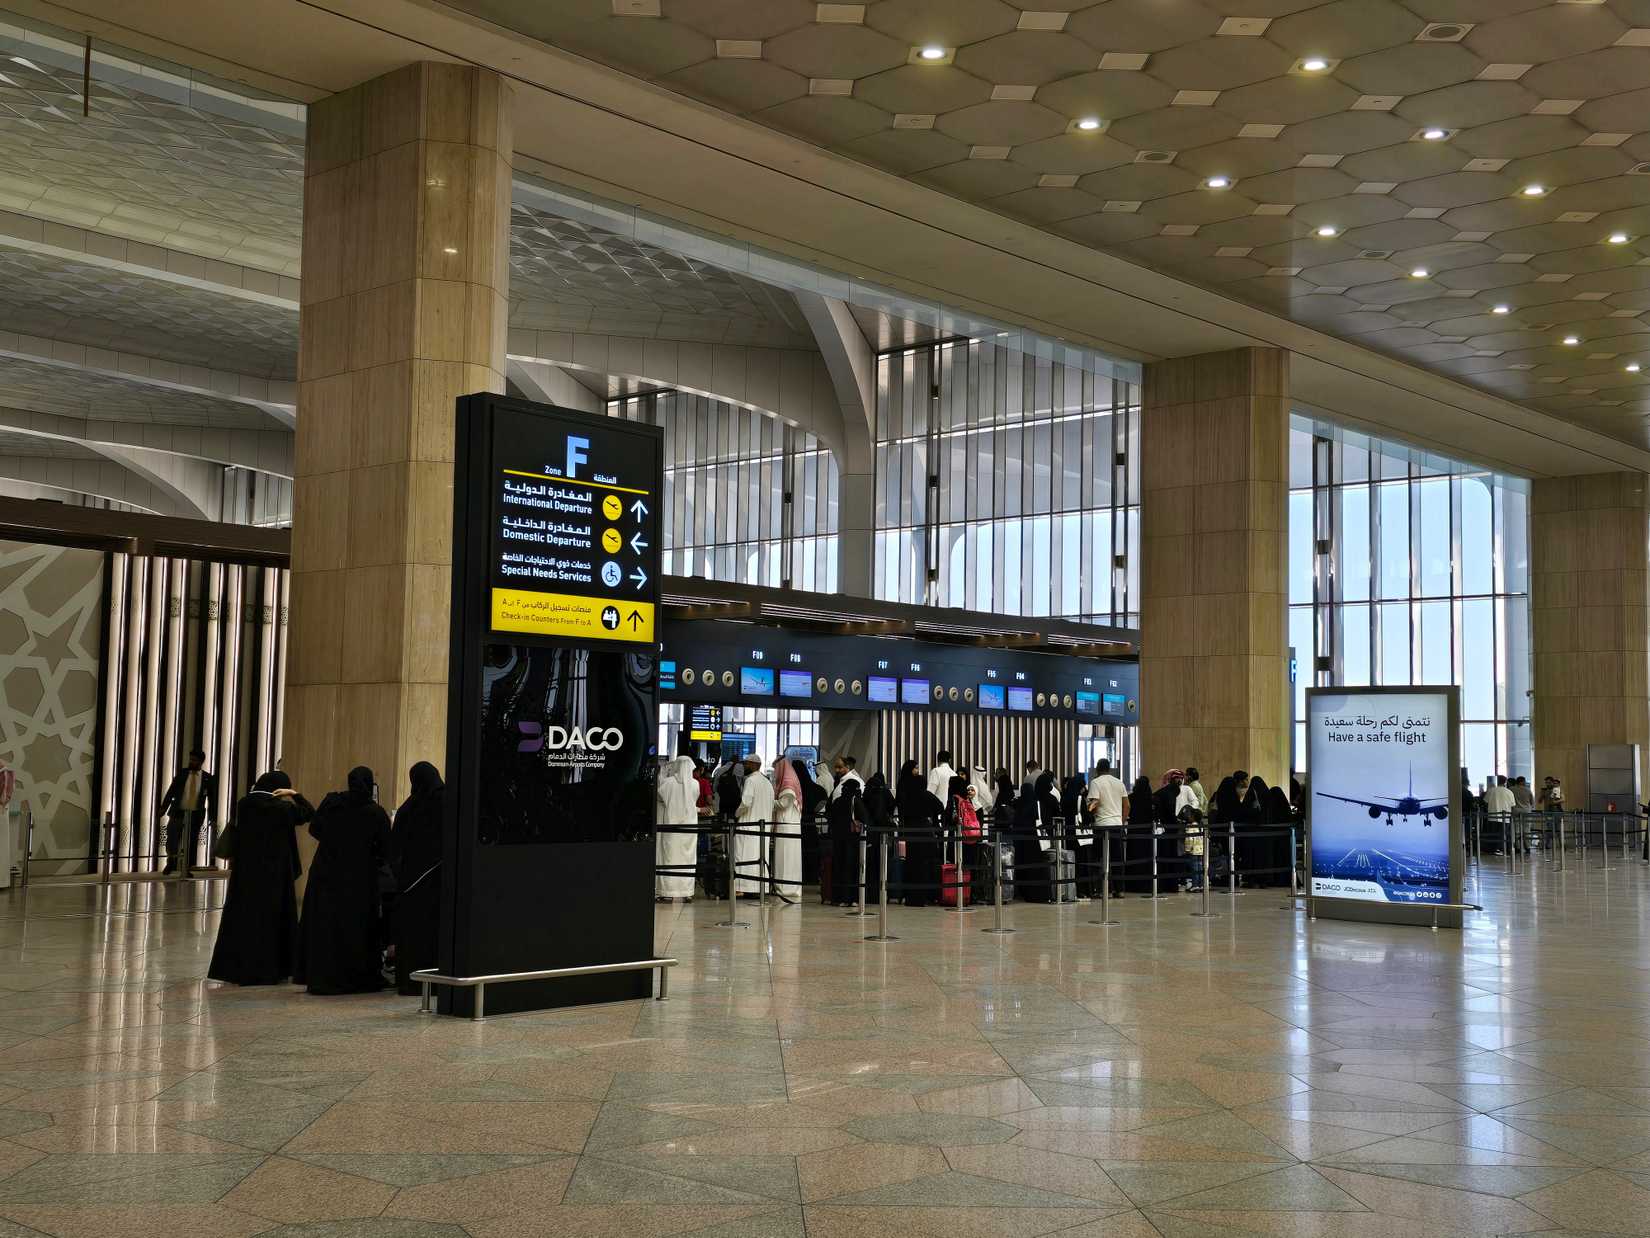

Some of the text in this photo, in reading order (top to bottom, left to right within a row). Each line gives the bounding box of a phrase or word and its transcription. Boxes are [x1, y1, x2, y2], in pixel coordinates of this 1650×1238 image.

[567, 435, 589, 477] F
[545, 465, 561, 476] Zone
[593, 474, 617, 484] المنطقة
[504, 480, 592, 502] المغادرة الدولية
[503, 493, 592, 514] International Departure
[502, 516, 591, 535] المغادرة الداخلية
[503, 528, 591, 548] Domestic Departure
[502, 552, 524, 562] الخاصة
[556, 560, 570, 569] ذوي
[571, 560, 591, 570] خدمات
[501, 564, 592, 582] Special Needs Services
[501, 611, 530, 621] Check-in
[531, 614, 560, 623] Counters
[1324, 715, 1431, 729] نتمنى لكم رحلة سعيدة
[549, 726, 623, 750] DACO
[1328, 731, 1426, 745] Have a safe flight
[589, 753, 606, 762] شركة
[1322, 883, 1341, 891] DACO
